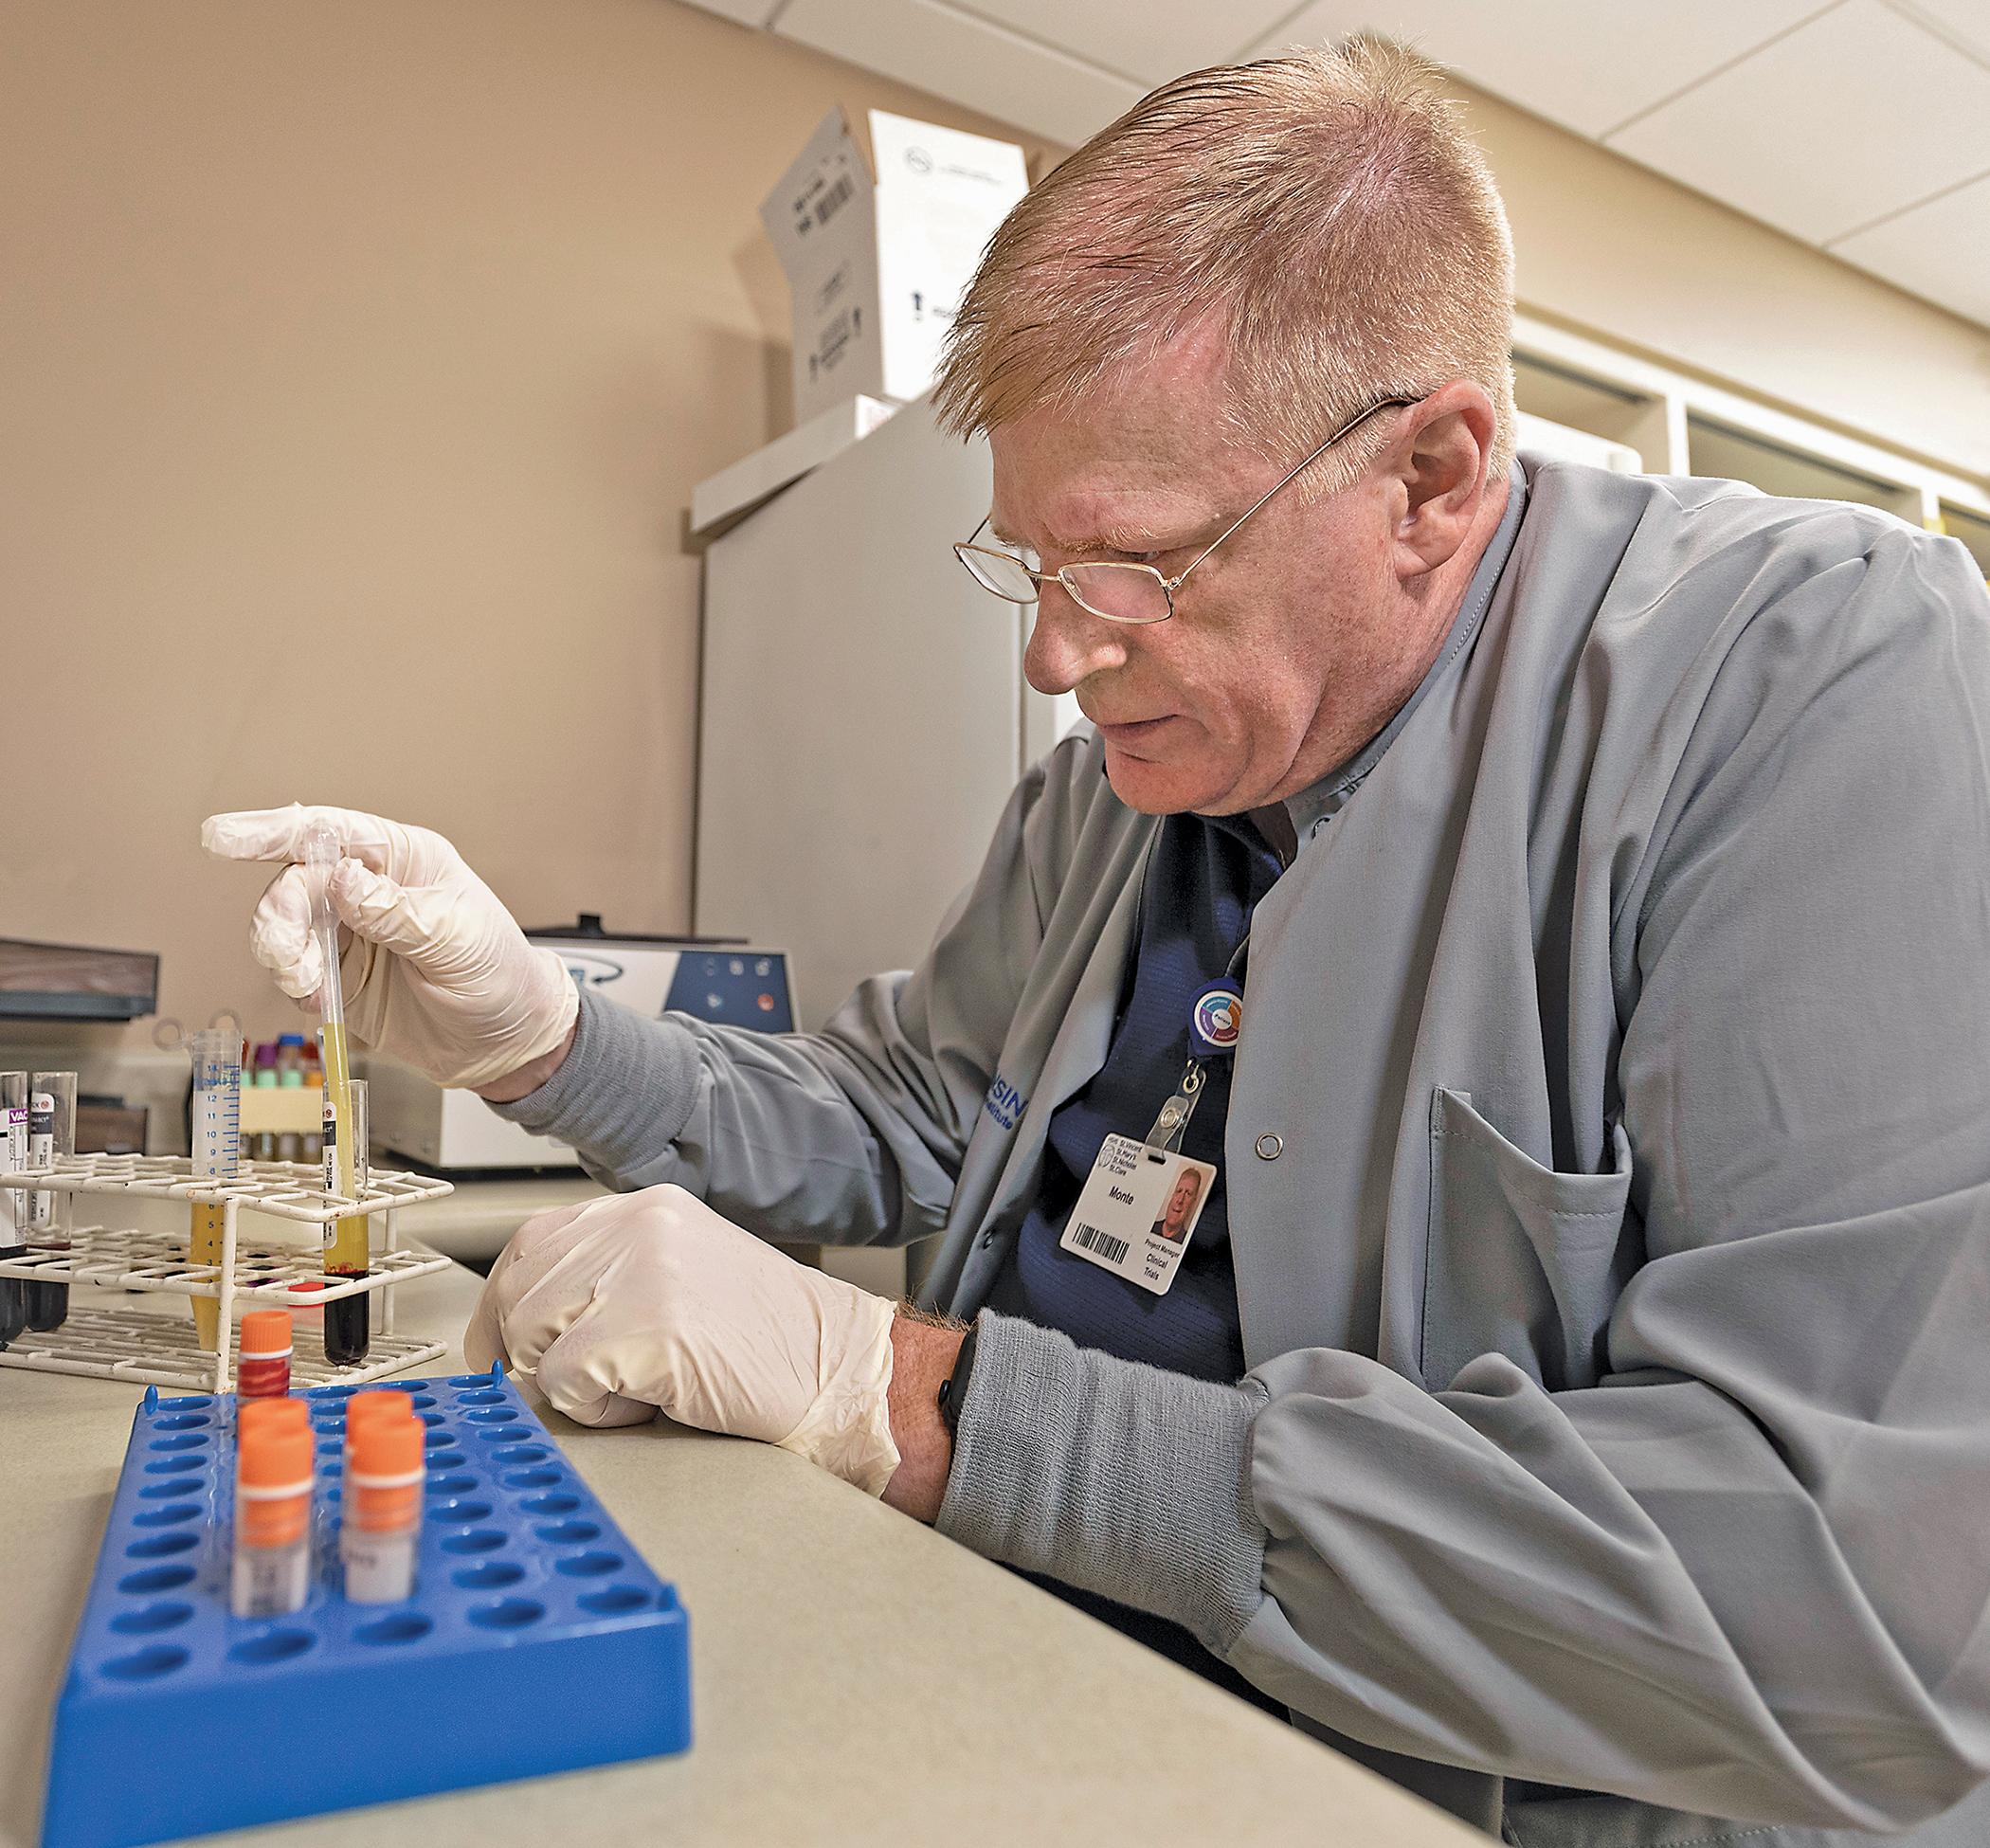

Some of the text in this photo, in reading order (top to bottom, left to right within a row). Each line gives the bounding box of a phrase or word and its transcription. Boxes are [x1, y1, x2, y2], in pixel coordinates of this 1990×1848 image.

[1109, 1186, 1134, 1205] Monte
[1147, 1253, 1168, 1269] Clinical
[1144, 1266, 1160, 1280] Trials
